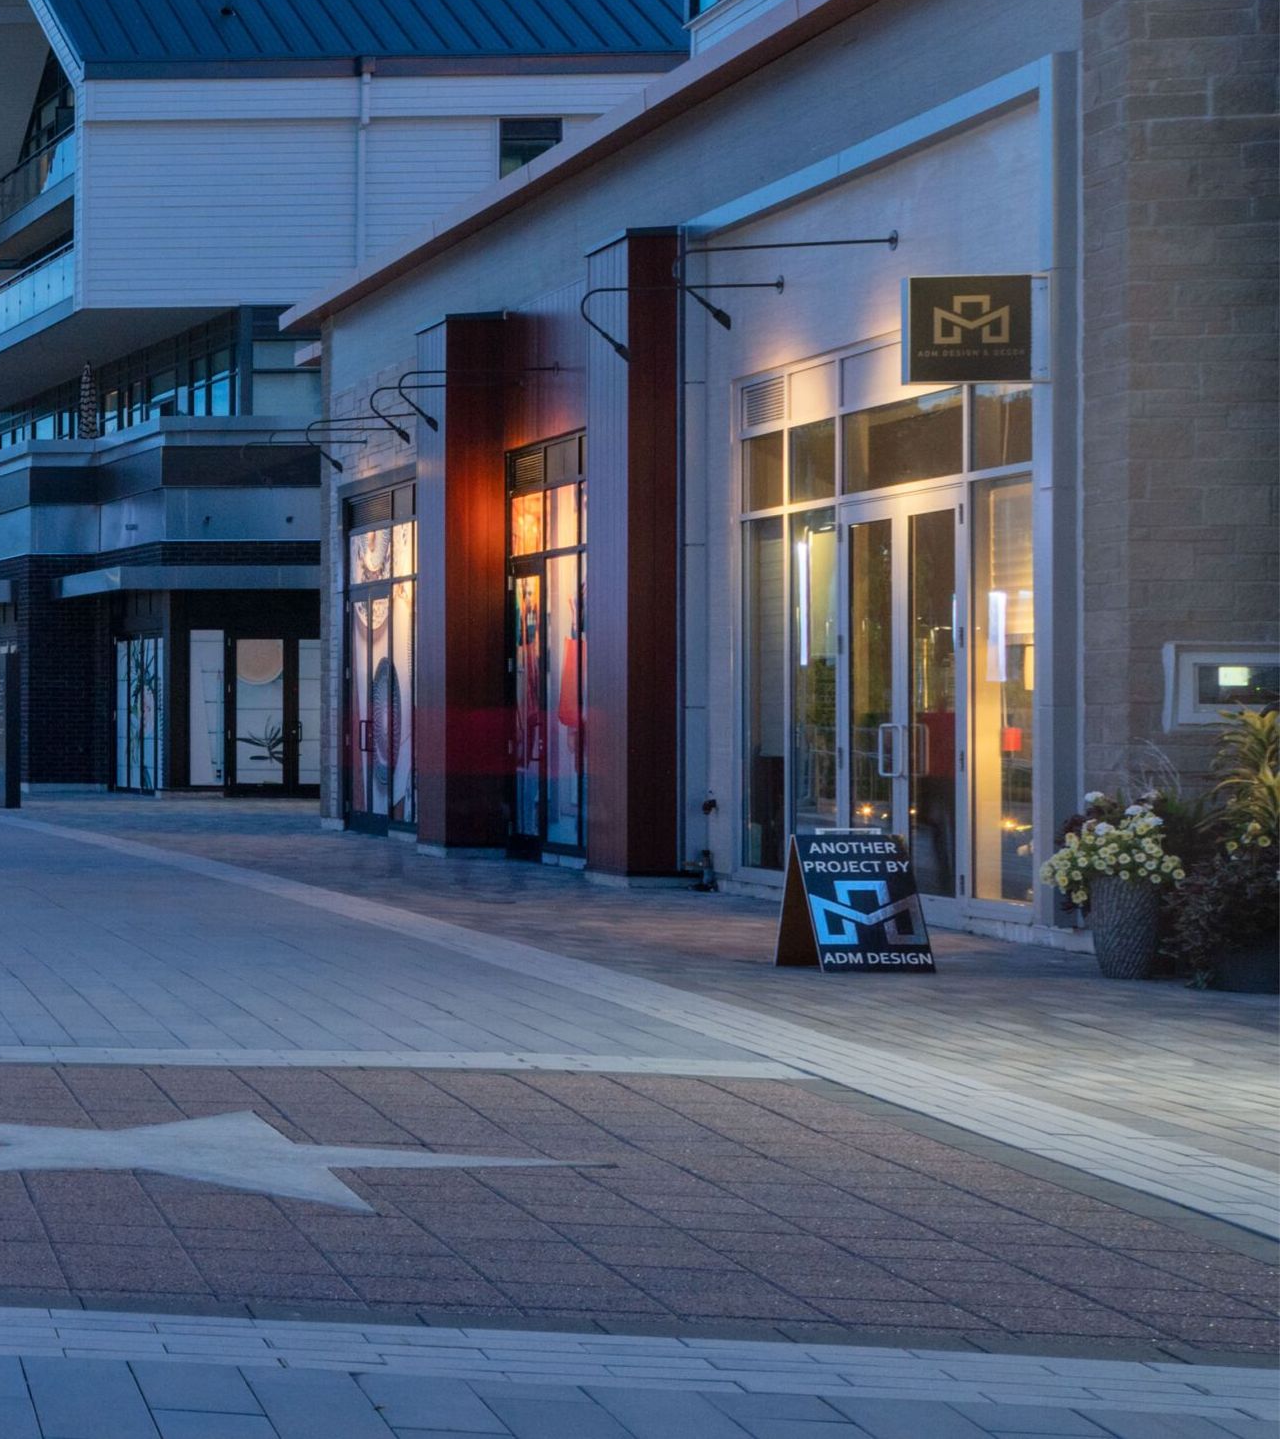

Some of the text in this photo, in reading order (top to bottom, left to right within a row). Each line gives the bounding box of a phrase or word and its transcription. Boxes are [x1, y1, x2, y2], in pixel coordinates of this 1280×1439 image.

[917, 350, 939, 358] ADM
[942, 349, 979, 358] DESIGN
[809, 841, 897, 854] ANOTHER
[803, 860, 910, 873] PROJECT BY
[823, 952, 933, 965] ADM DESIGN
